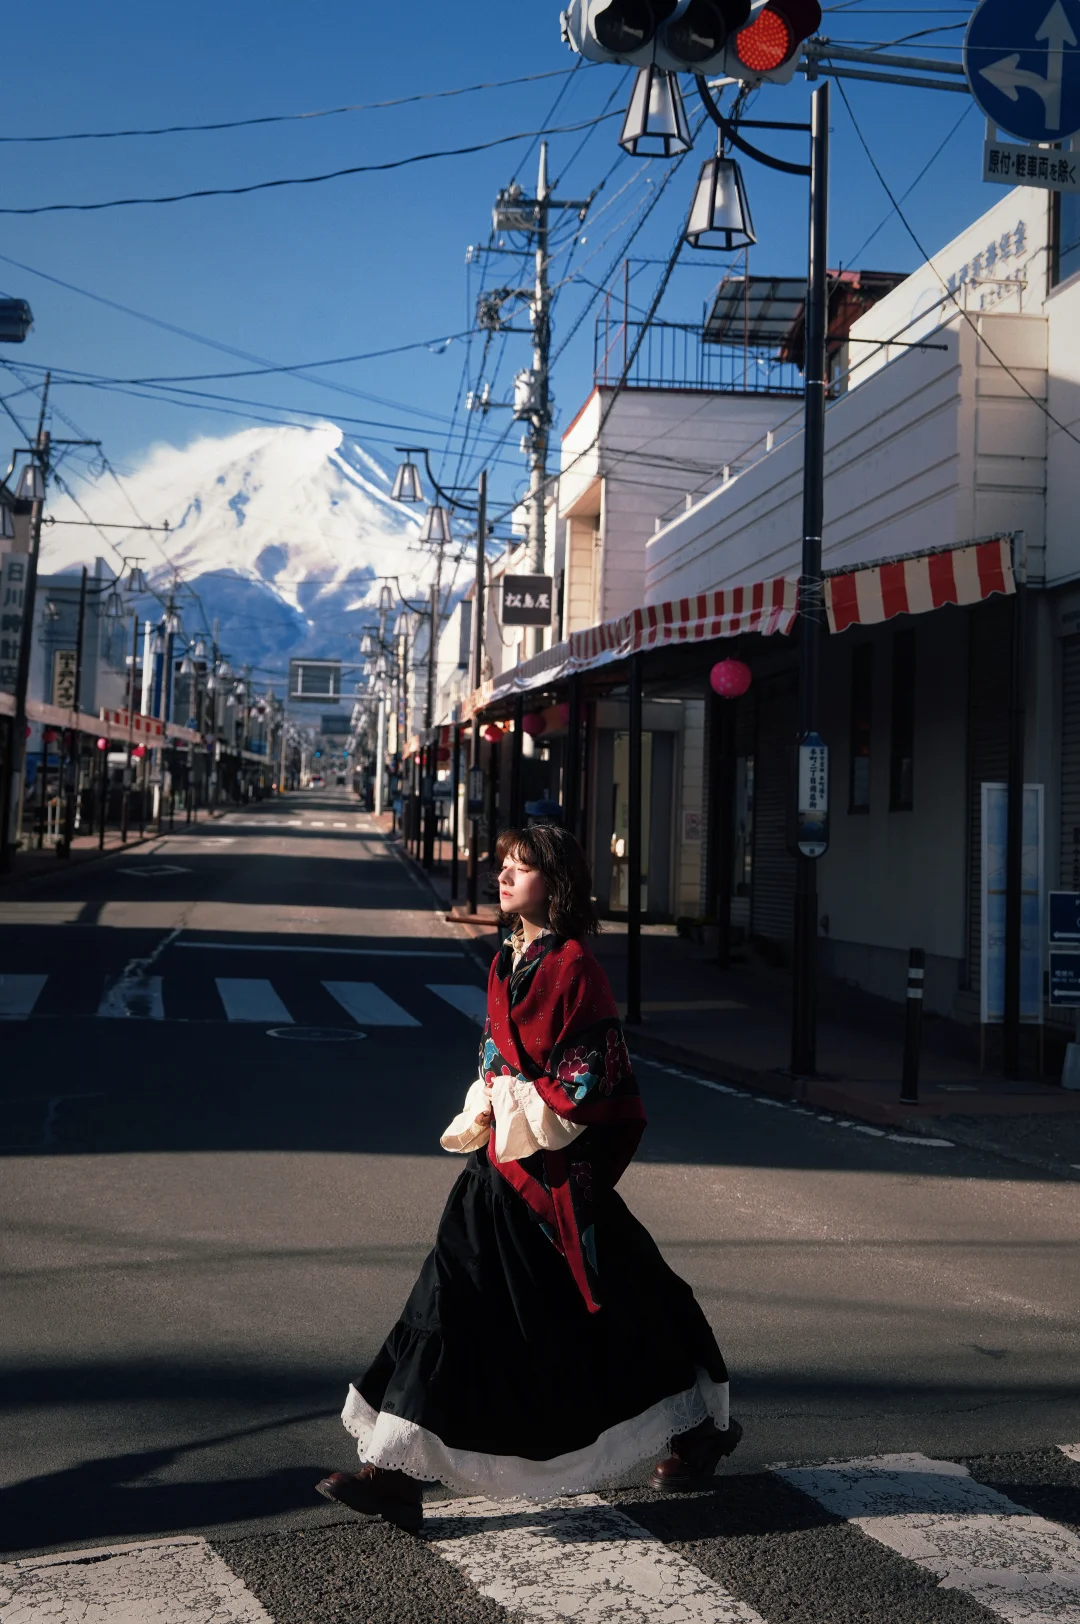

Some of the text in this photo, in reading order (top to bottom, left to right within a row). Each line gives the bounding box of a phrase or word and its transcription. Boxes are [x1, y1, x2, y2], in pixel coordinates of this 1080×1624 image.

[988, 149, 1076, 184] 原付・軽車両を除く
[809, 748, 818, 809] 本町二丁目商店街
